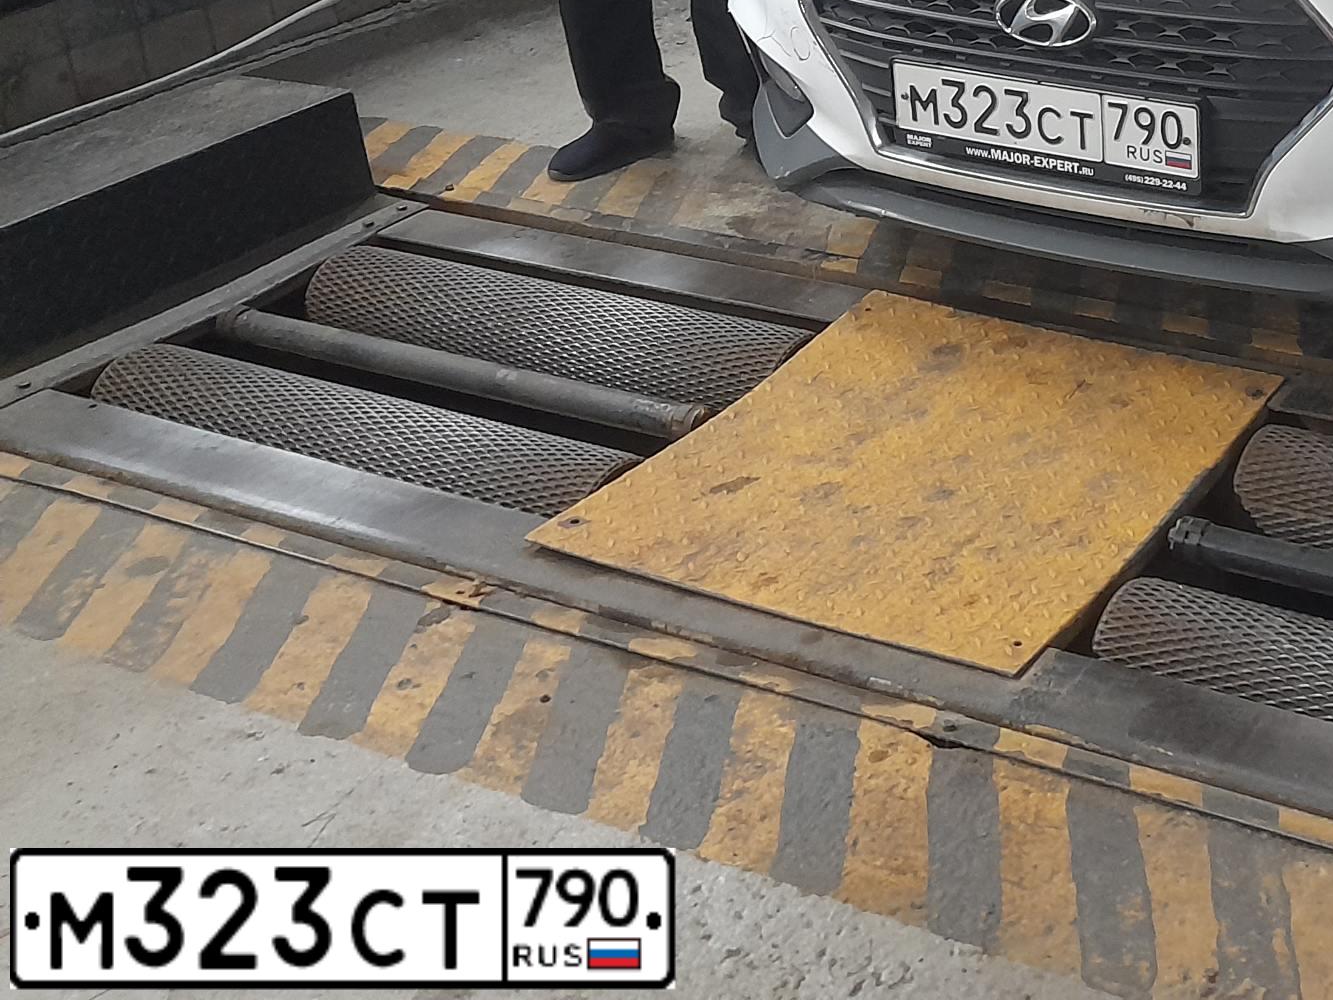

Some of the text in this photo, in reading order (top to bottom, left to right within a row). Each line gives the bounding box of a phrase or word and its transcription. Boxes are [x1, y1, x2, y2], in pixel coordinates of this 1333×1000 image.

[908, 77, 1185, 150] М323СТ 790
[1126, 145, 1164, 164] RUS
